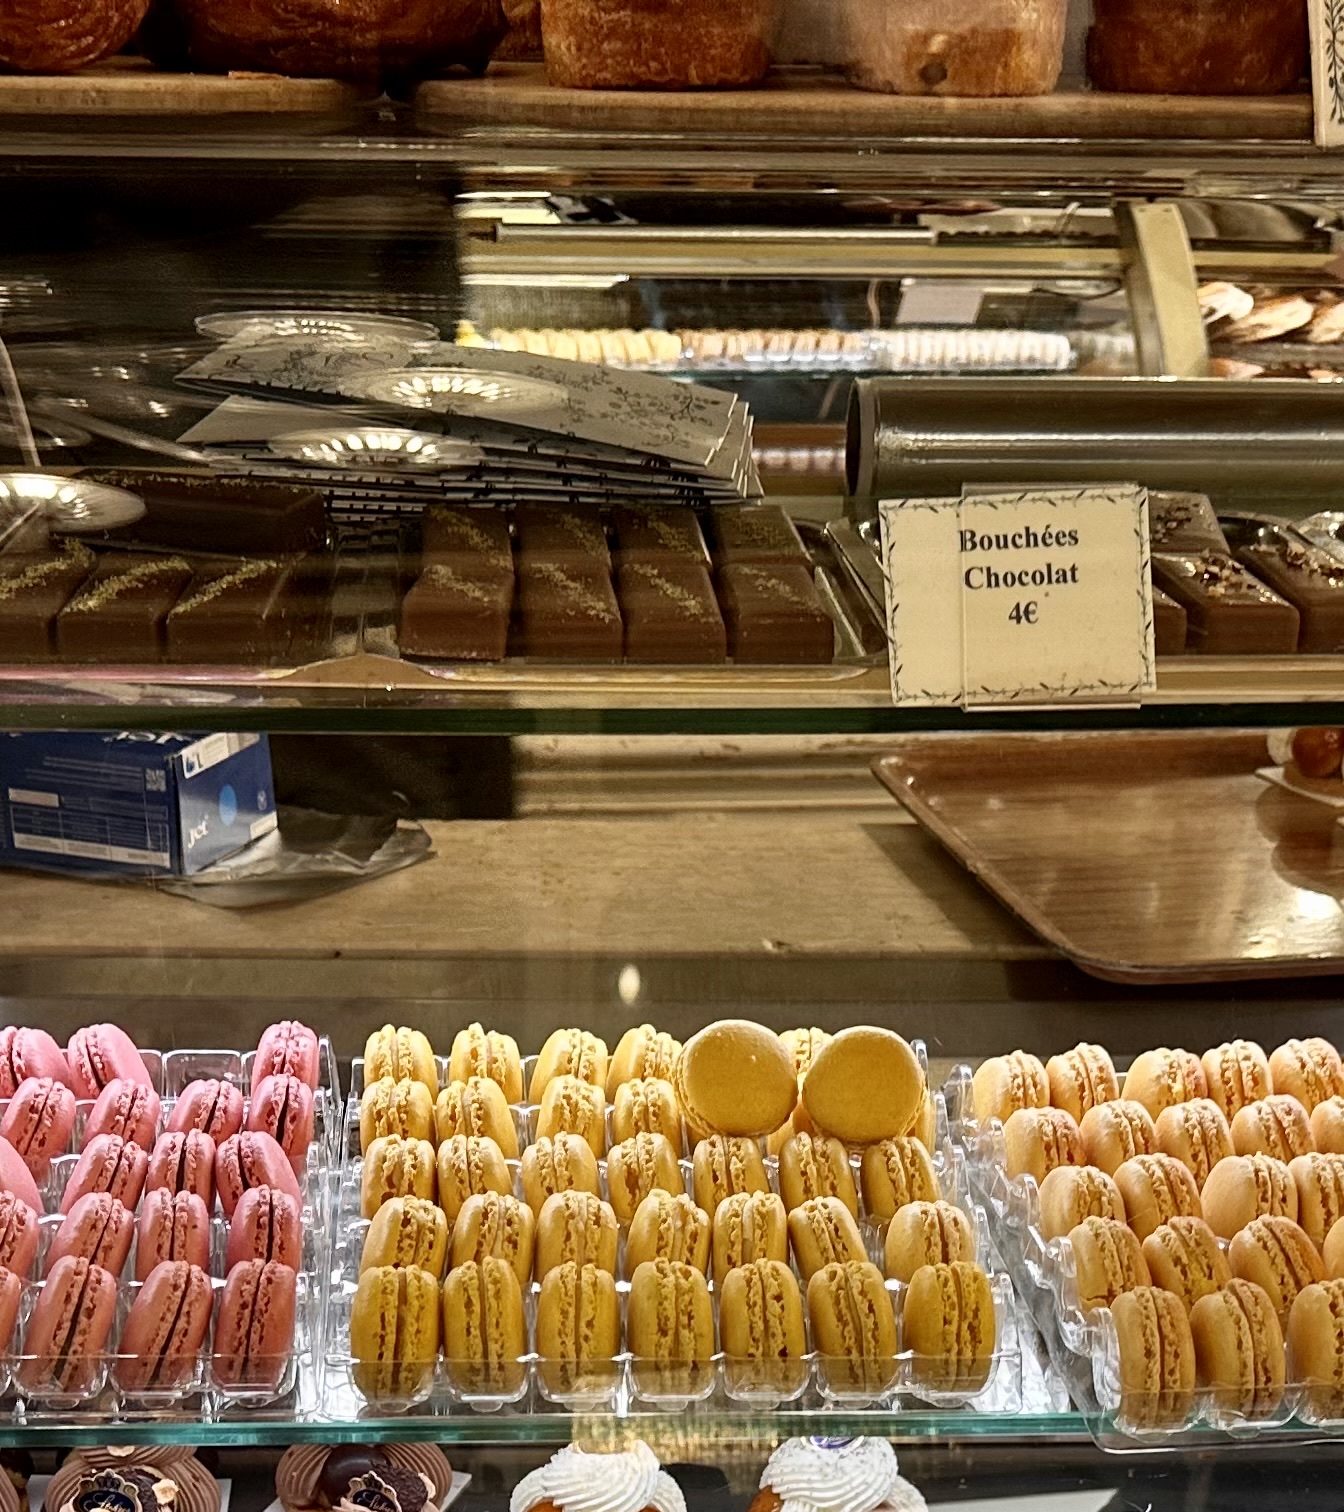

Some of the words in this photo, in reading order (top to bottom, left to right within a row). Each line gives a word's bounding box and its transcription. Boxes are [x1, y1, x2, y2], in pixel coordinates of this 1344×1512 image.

[960, 524, 1079, 551] Bouchées
[964, 563, 1079, 589] Chocolat
[1008, 601, 1039, 625] 4€
